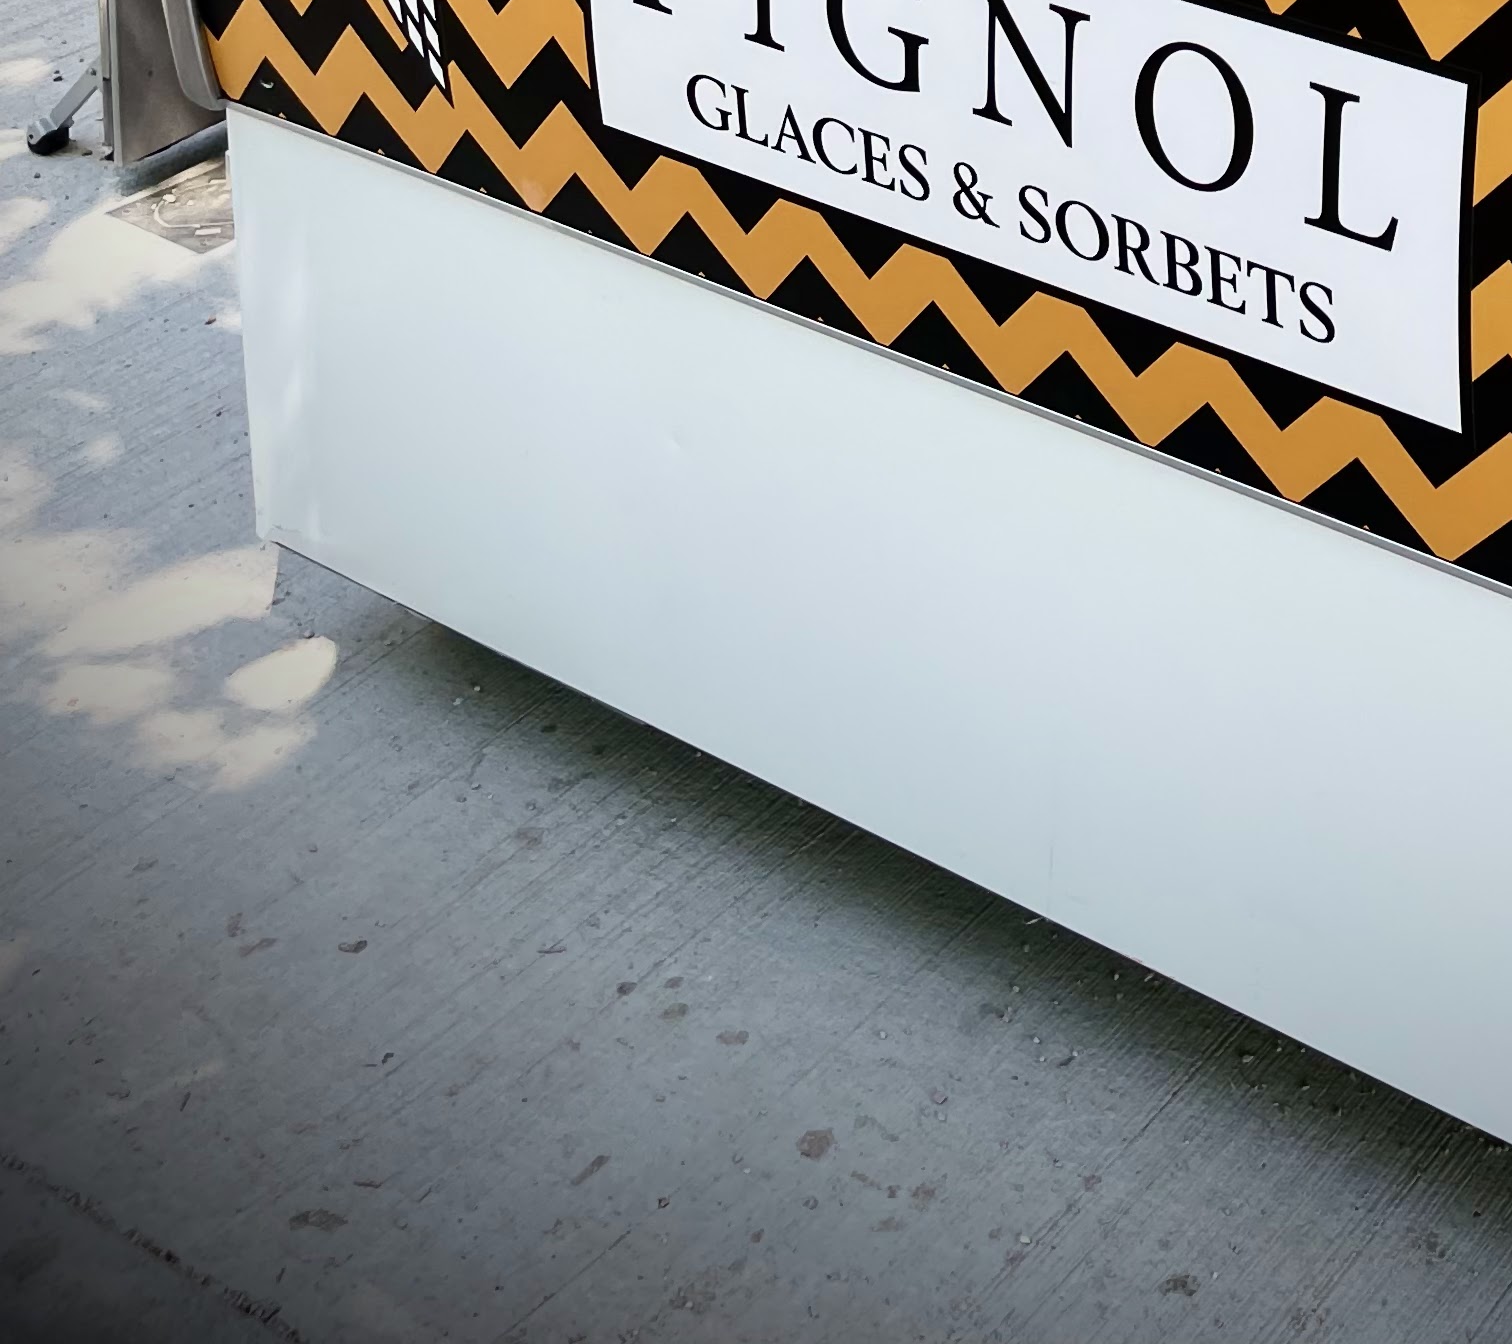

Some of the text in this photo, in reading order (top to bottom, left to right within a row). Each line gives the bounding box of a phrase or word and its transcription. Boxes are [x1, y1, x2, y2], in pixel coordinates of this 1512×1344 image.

[686, 73, 1336, 345] GLACES & SORBETS
